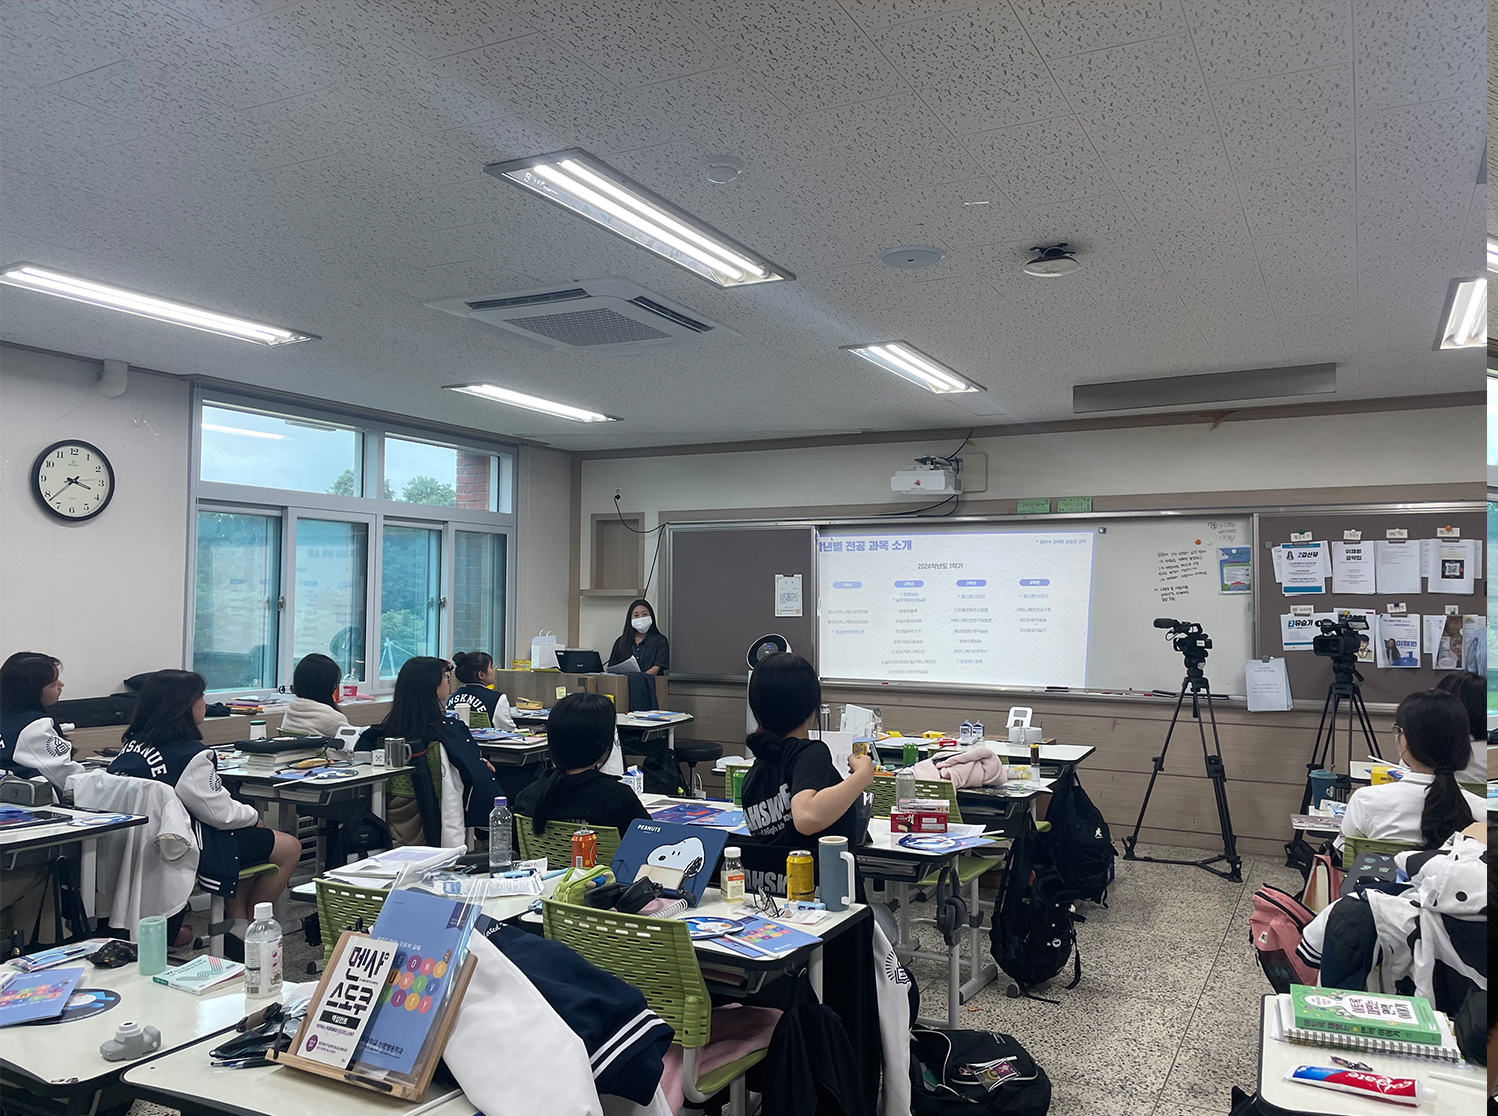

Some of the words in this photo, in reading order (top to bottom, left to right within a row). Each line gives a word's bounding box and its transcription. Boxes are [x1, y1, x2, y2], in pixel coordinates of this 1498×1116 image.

[845, 540, 866, 552] 전공
[868, 540, 889, 551] 과목
[892, 540, 912, 550] 소개
[917, 562, 948, 570] 2024학년도
[949, 562, 964, 570] 1학기
[346, 946, 386, 982] 멘사
[326, 982, 374, 1015] 스도쿠
